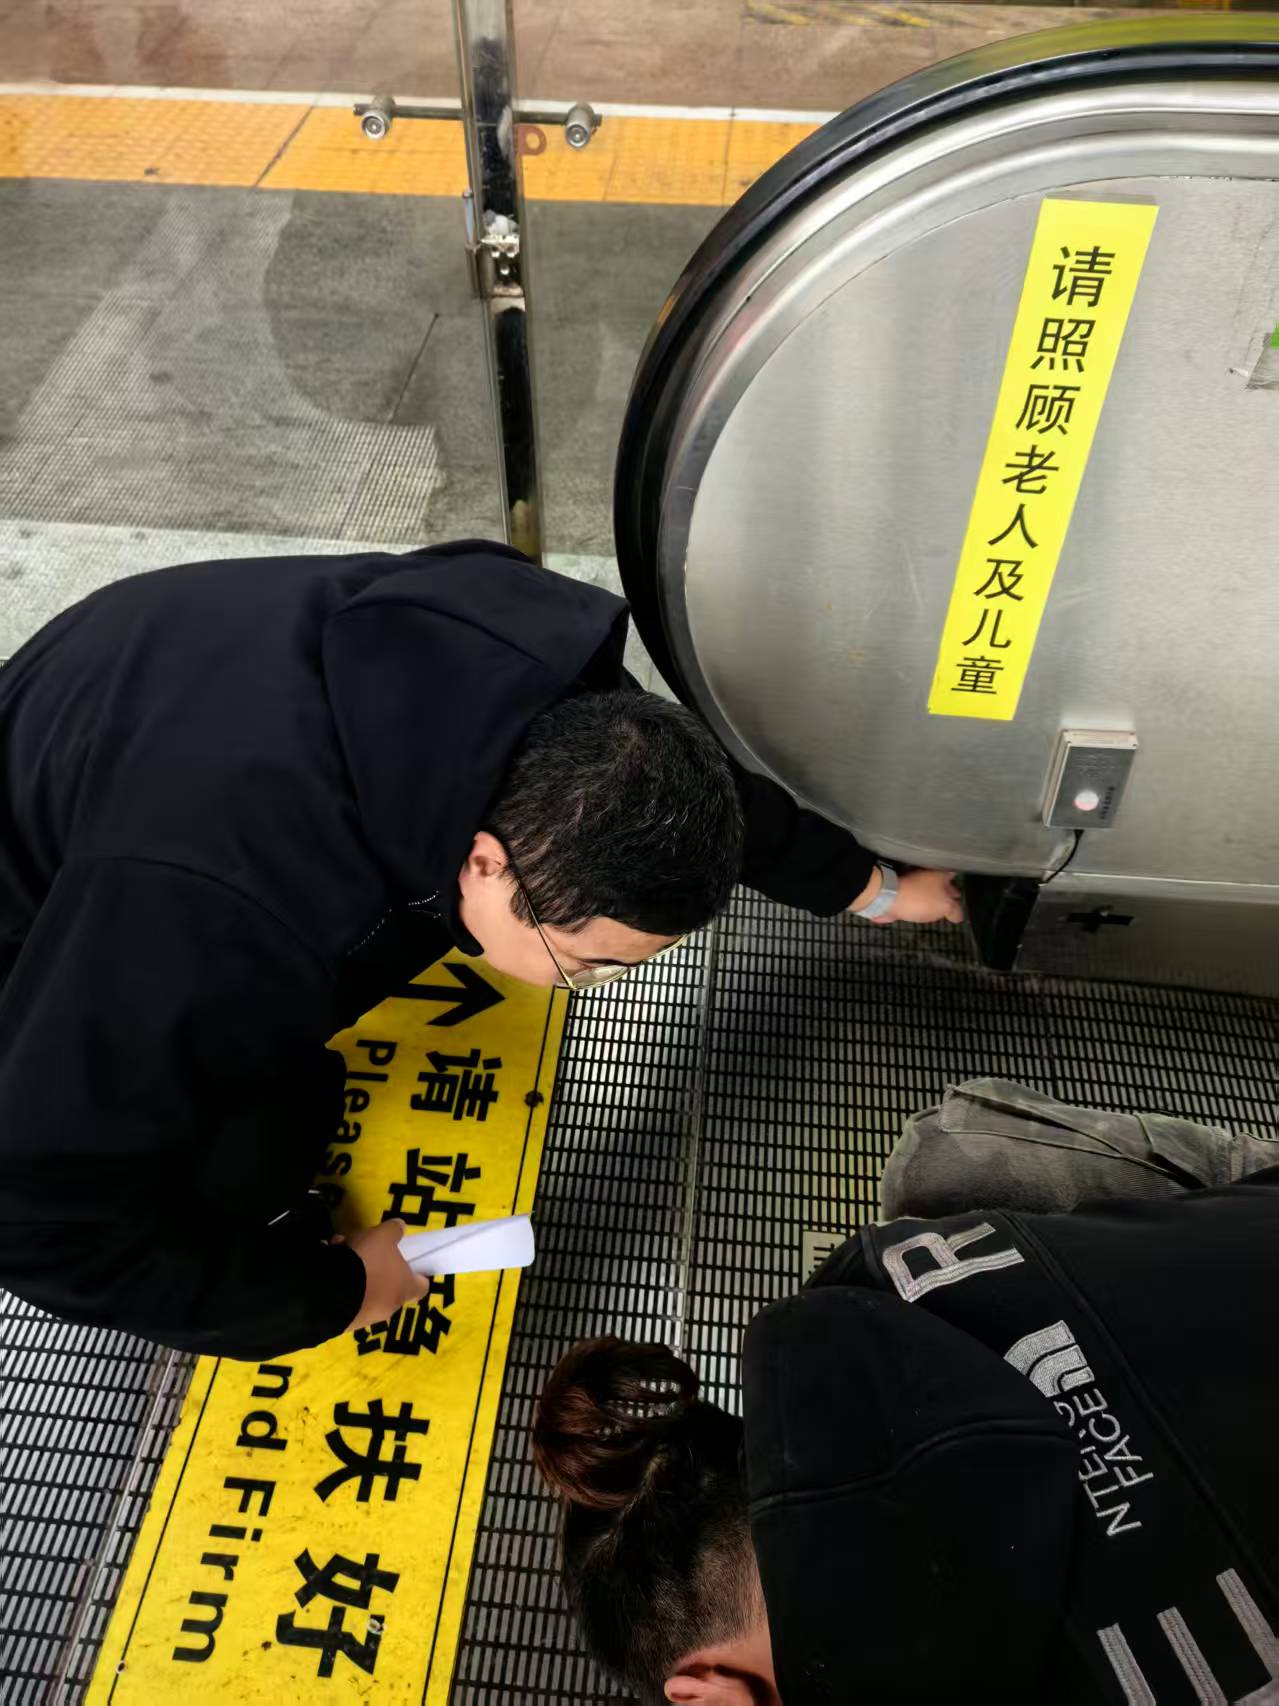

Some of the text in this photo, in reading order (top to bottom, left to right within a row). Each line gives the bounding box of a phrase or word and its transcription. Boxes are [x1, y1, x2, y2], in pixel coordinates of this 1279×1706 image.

[951, 246, 1115, 694] 请照顾老人及儿童
[1072, 1388, 1154, 1487] FACE
[172, 1476, 277, 1663] Firm
